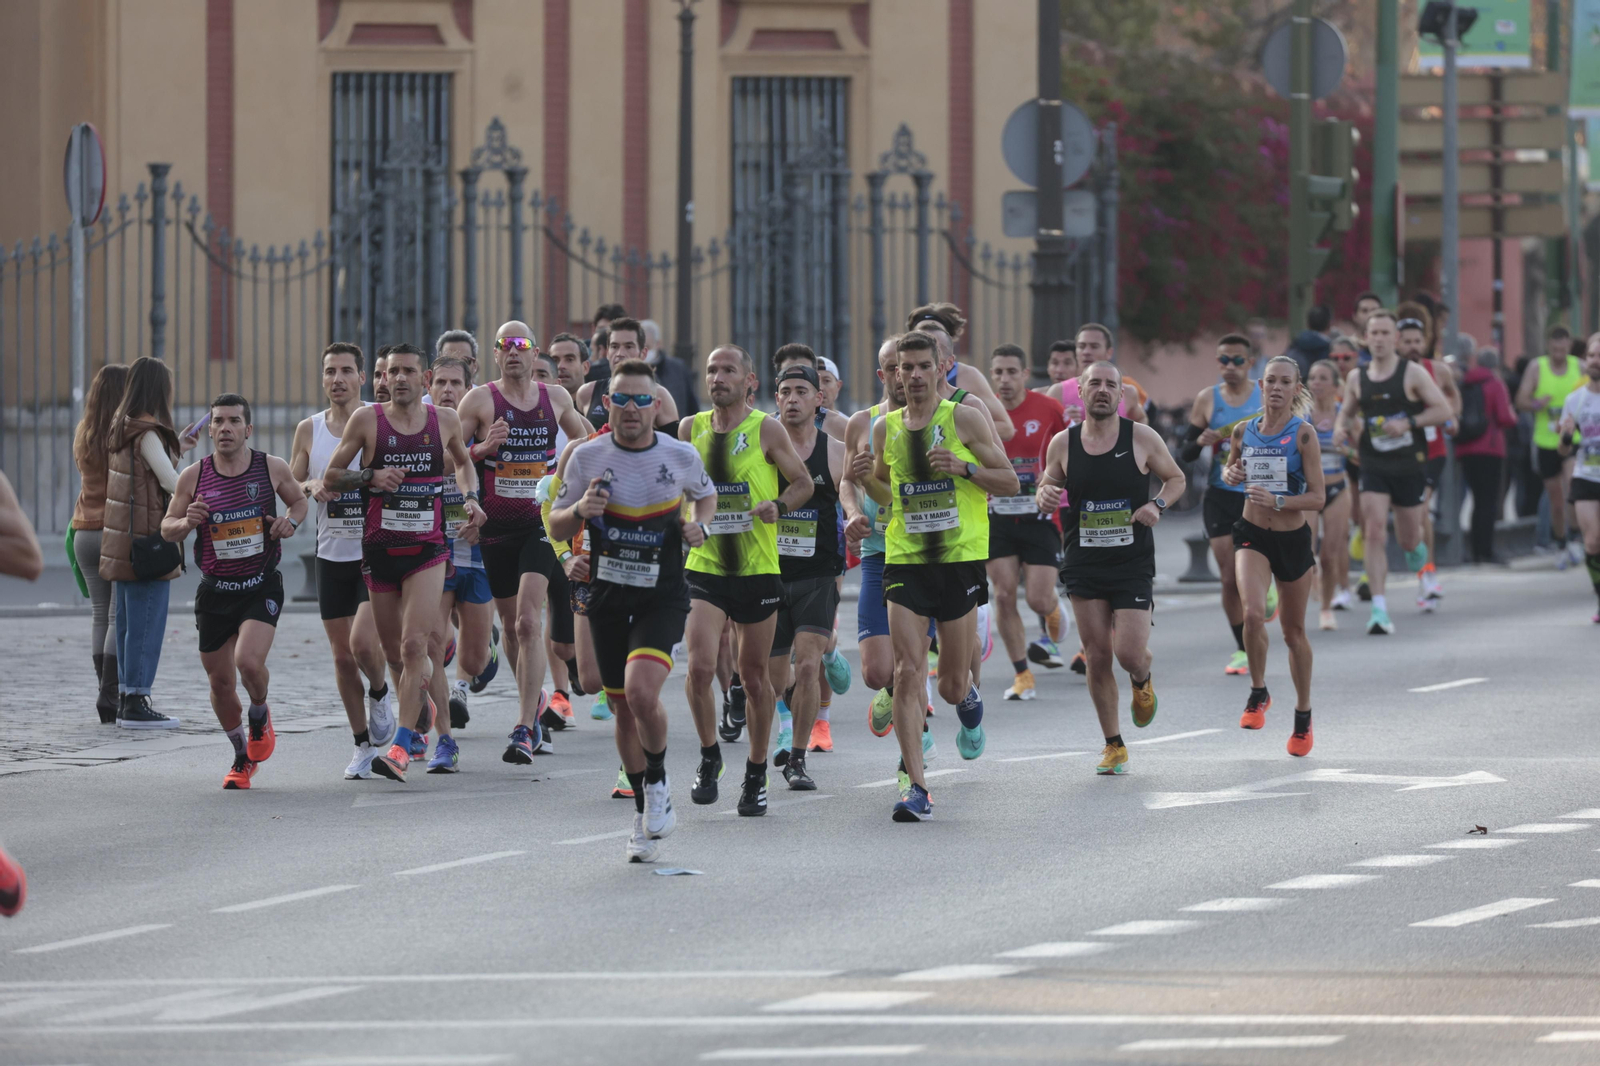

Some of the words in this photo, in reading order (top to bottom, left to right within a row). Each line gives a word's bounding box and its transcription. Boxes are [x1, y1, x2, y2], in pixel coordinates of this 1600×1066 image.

[384, 453, 432, 462] OCTAVUS
[916, 482, 948, 492] ZURICH
[400, 500, 419, 508] 2989
[919, 500, 937, 508] 1576
[224, 509, 255, 520] ZURICH
[930, 511, 950, 519] MARIO
[228, 527, 246, 536] 3861
[781, 525, 799, 534] 1349
[621, 532, 656, 543] ZURICH
[226, 538, 252, 547] PAULINO
[619, 549, 640, 559] 2591
[607, 560, 624, 569] PEPE
[625, 564, 651, 573] VALERO
[242, 574, 264, 590] MAX
